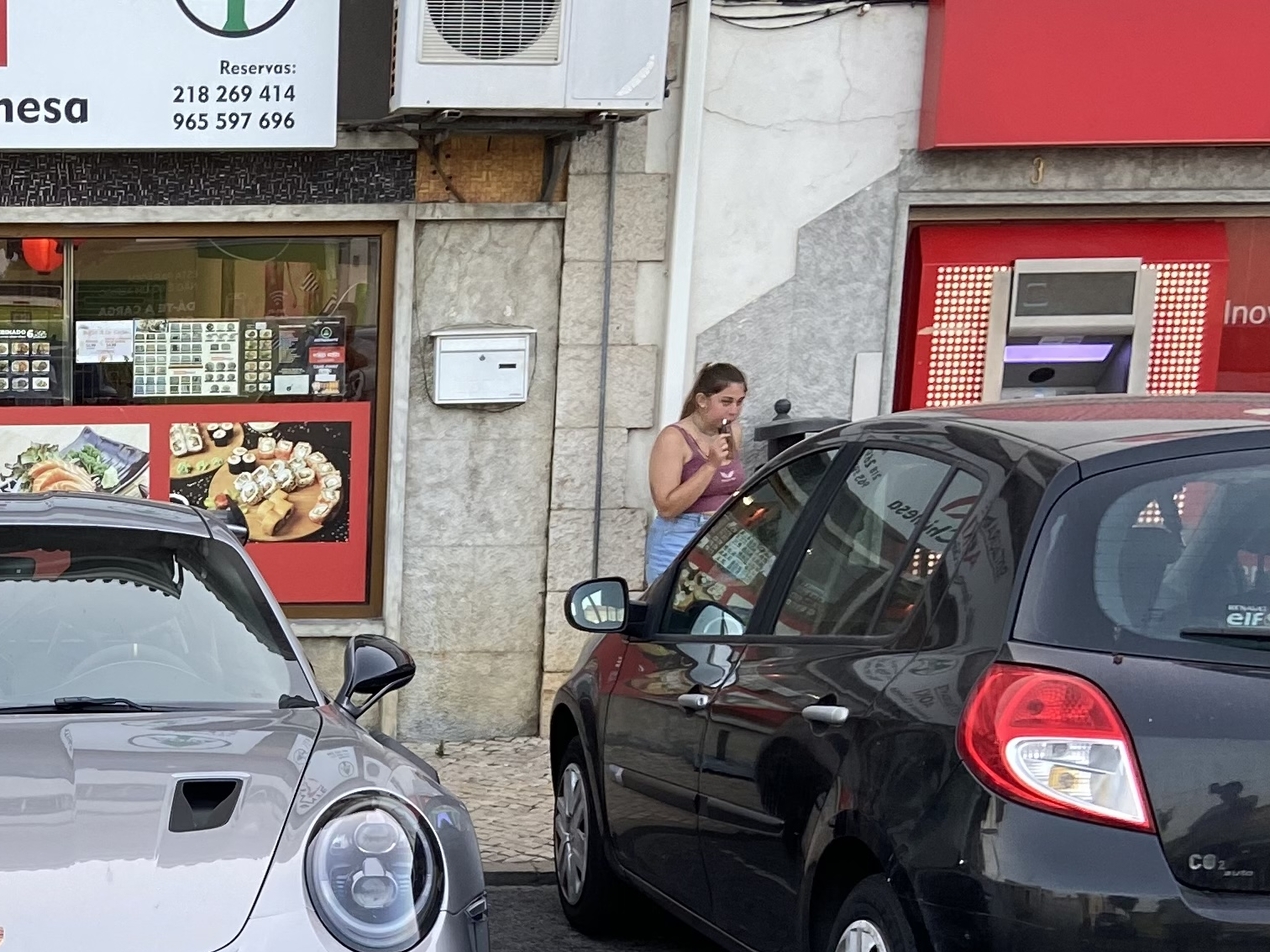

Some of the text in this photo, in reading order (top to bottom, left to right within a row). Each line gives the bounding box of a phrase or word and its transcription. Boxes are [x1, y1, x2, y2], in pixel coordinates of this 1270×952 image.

[219, 60, 297, 75] Reservas:
[172, 84, 296, 103] 218 269 414
[172, 112, 296, 130] 965 597 696
[1223, 299, 1270, 325] Ino
